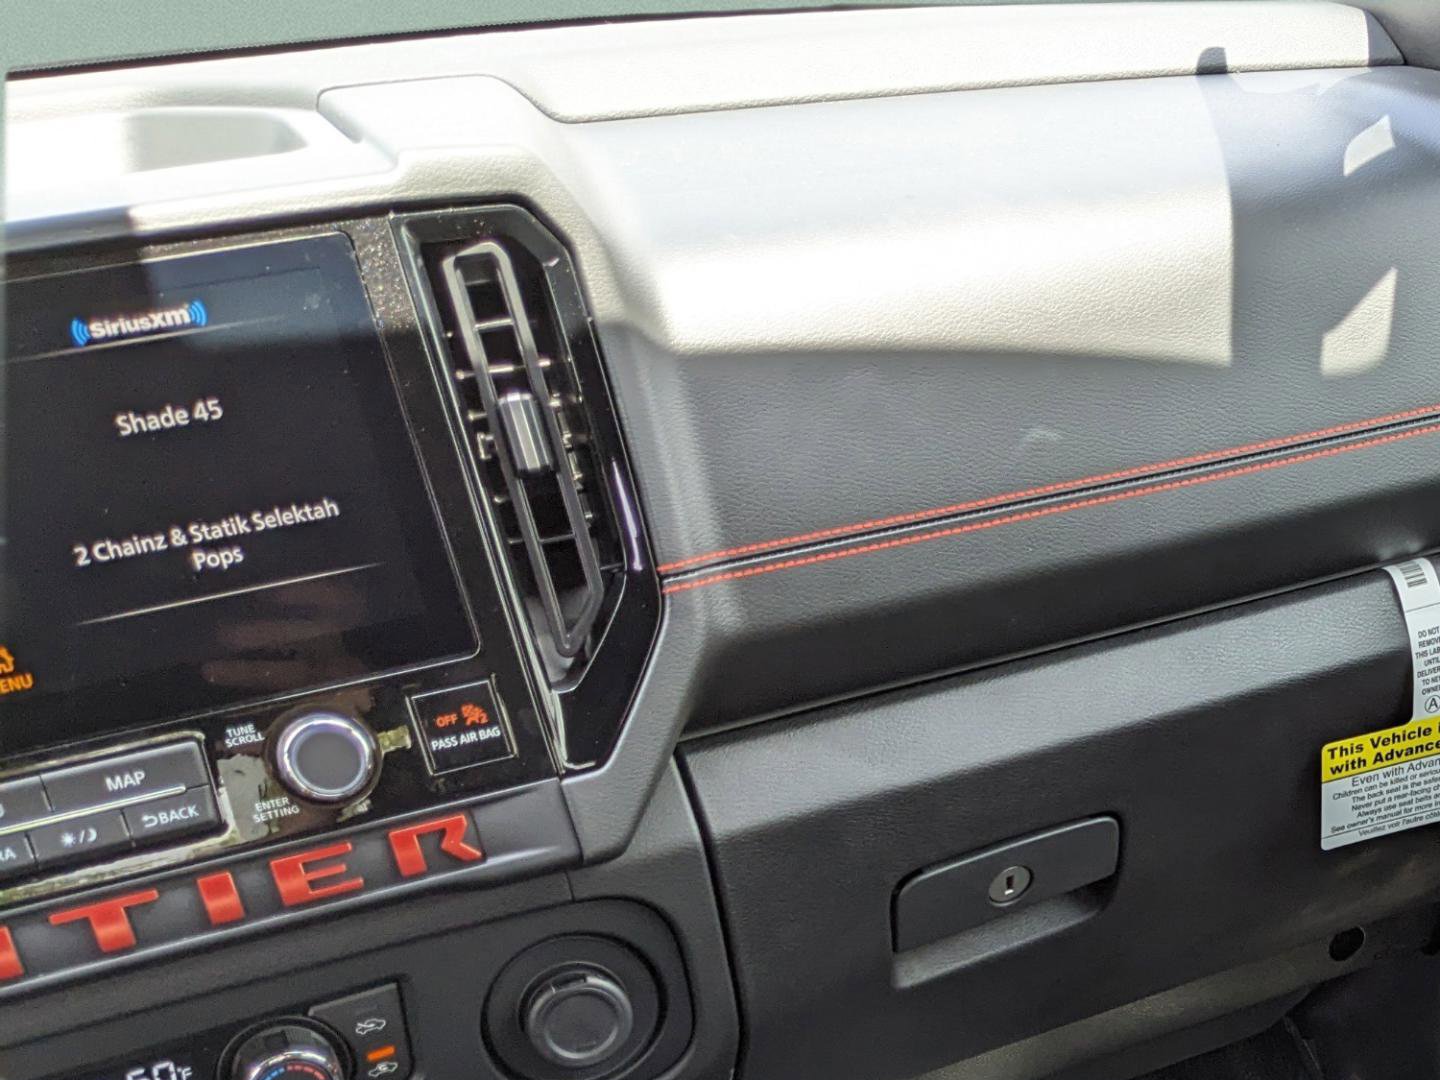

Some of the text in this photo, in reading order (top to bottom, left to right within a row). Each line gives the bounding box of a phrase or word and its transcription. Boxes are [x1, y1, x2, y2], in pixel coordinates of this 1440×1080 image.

[115, 399, 224, 438] Shade 45
[73, 498, 341, 568] 2 Chainz & Statik Selektah
[192, 546, 244, 571] Pops
[1417, 625, 1440, 639] DO NOT
[1415, 649, 1428, 660] THIS
[1424, 656, 1440, 667] UNTIL
[0, 672, 34, 693] ENU
[1422, 678, 1430, 686] TO
[225, 723, 256, 738] TUNE
[435, 713, 458, 728] OFF
[224, 731, 265, 748] SCROLL
[431, 726, 501, 751] PASS AIR BAG
[1327, 743, 1364, 760] This
[1370, 726, 1433, 749] Vehicle
[1330, 757, 1367, 775] with
[1352, 773, 1379, 787] Even
[1382, 766, 1405, 779] with
[105, 770, 146, 792] MAP
[1332, 787, 1362, 801] Children
[1364, 784, 1377, 793] can
[1379, 780, 1388, 789] be
[1390, 775, 1408, 786] killed
[1409, 773, 1417, 781] or
[1352, 795, 1366, 803] The
[1367, 789, 1384, 799] back
[1386, 785, 1401, 795] seat
[1402, 783, 1409, 791] is
[1410, 780, 1422, 789] the
[254, 796, 290, 812] ENTER
[1352, 801, 1373, 811] Never
[1374, 797, 1386, 807] put
[1394, 785, 1432, 802] rear-facing
[1357, 807, 1382, 818] Always
[1384, 803, 1397, 811] use
[1398, 798, 1414, 808] seat
[1415, 794, 1432, 804] belts
[158, 804, 200, 825] BACK
[252, 804, 300, 823] SETTING
[1331, 825, 1346, 833] See
[1346, 817, 1375, 829] owner's
[1376, 810, 1402, 821] manual
[1403, 807, 1413, 815] for
[1414, 802, 1433, 812] more
